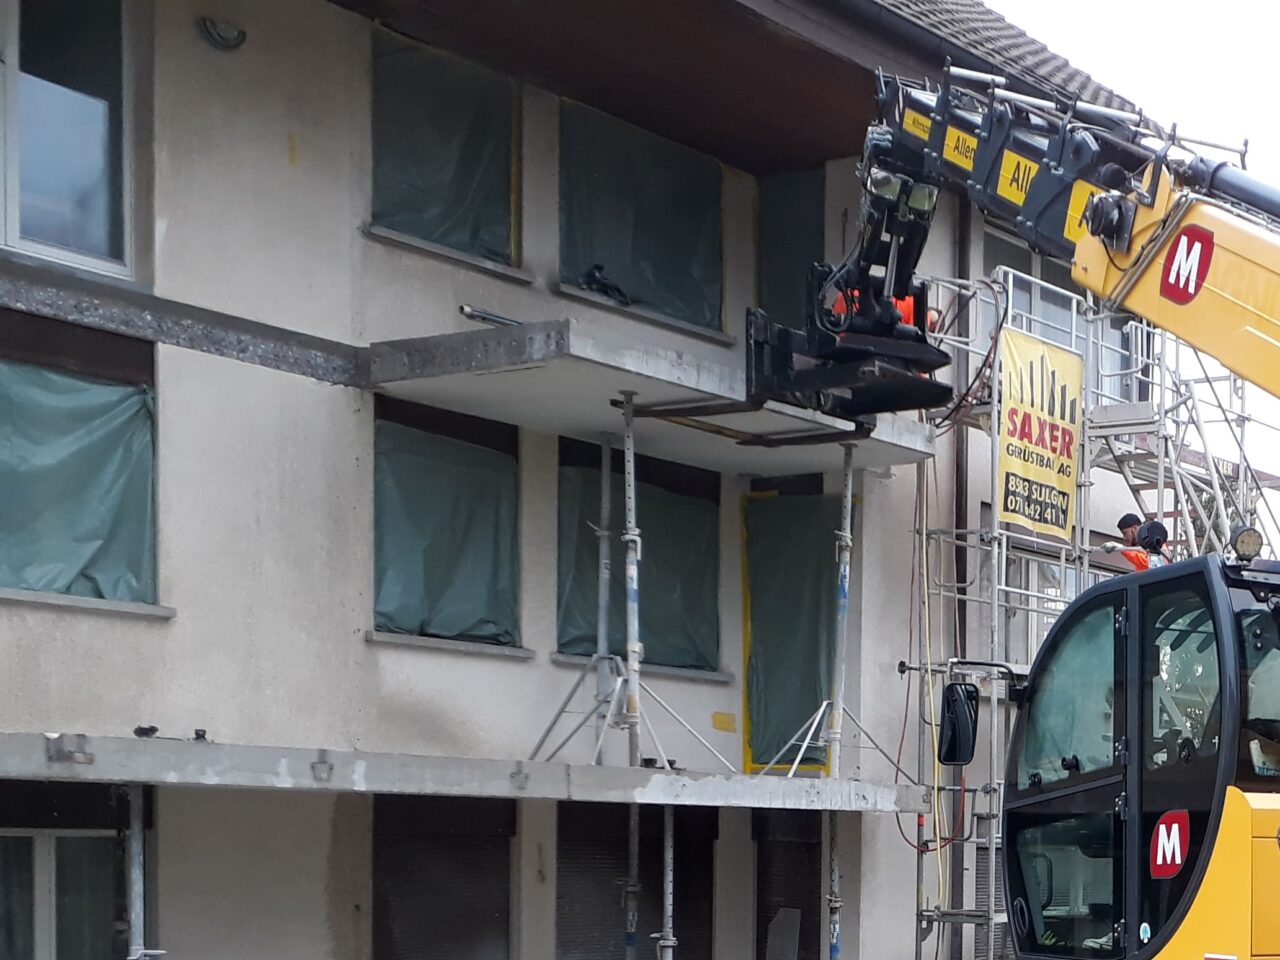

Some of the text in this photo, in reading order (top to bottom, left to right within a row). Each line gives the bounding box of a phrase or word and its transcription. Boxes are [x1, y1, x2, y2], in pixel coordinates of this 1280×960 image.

[1168, 234, 1202, 295] M
[1007, 407, 1074, 460] SAXER
[1056, 461, 1073, 478] AG
[1024, 501, 1041, 520] 642
[1031, 484, 1068, 511] SULGN
[1155, 823, 1182, 865] M
